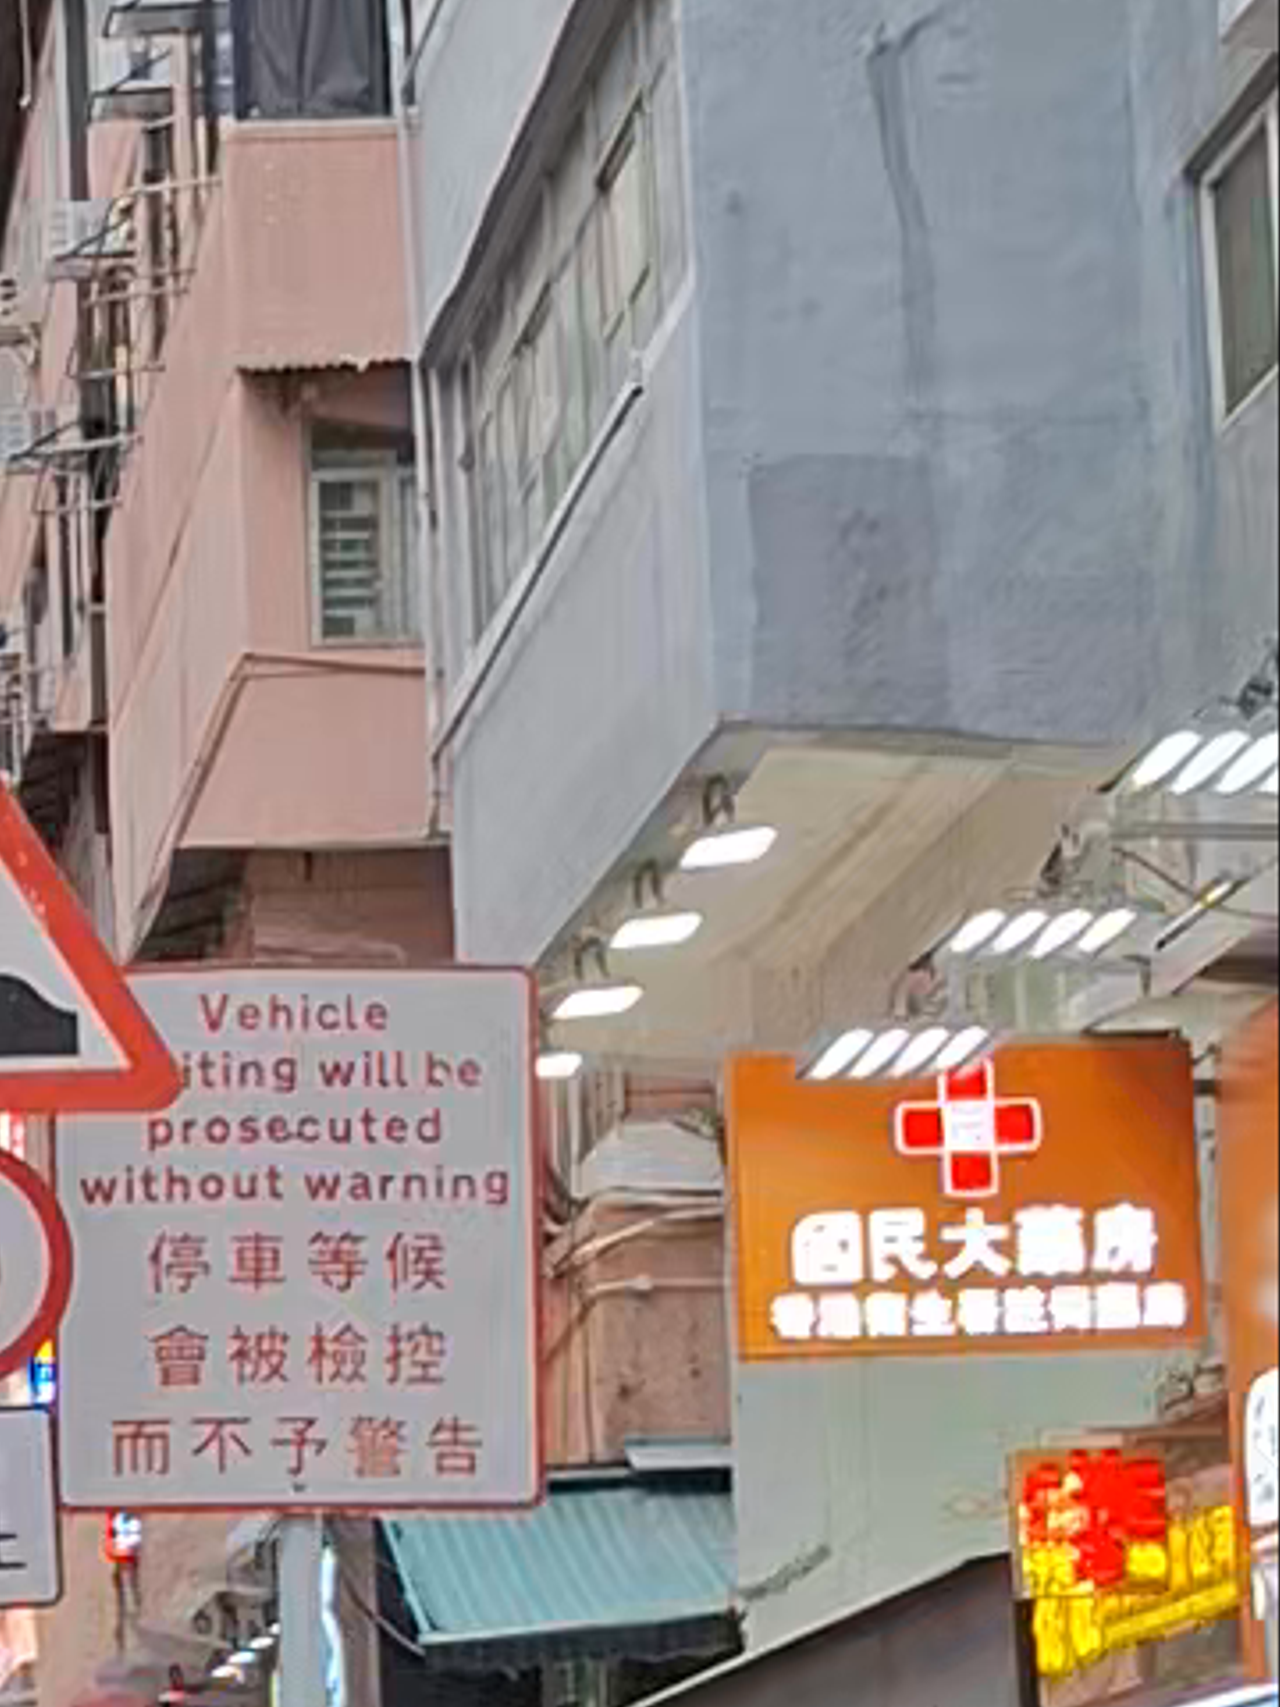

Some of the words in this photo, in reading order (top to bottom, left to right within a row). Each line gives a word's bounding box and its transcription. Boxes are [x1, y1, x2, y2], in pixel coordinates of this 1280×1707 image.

[200, 993, 389, 1033] Vehicle
[182, 1054, 299, 1093] iting
[319, 1053, 407, 1089] will
[426, 1052, 482, 1089] be
[147, 1107, 443, 1152] prosecuted
[80, 1165, 285, 1207] without
[305, 1167, 511, 1207] warning
[147, 1232, 447, 1295] 停車等候
[147, 1324, 447, 1389] 會被檢控
[111, 1417, 483, 1480] 而不予警告
